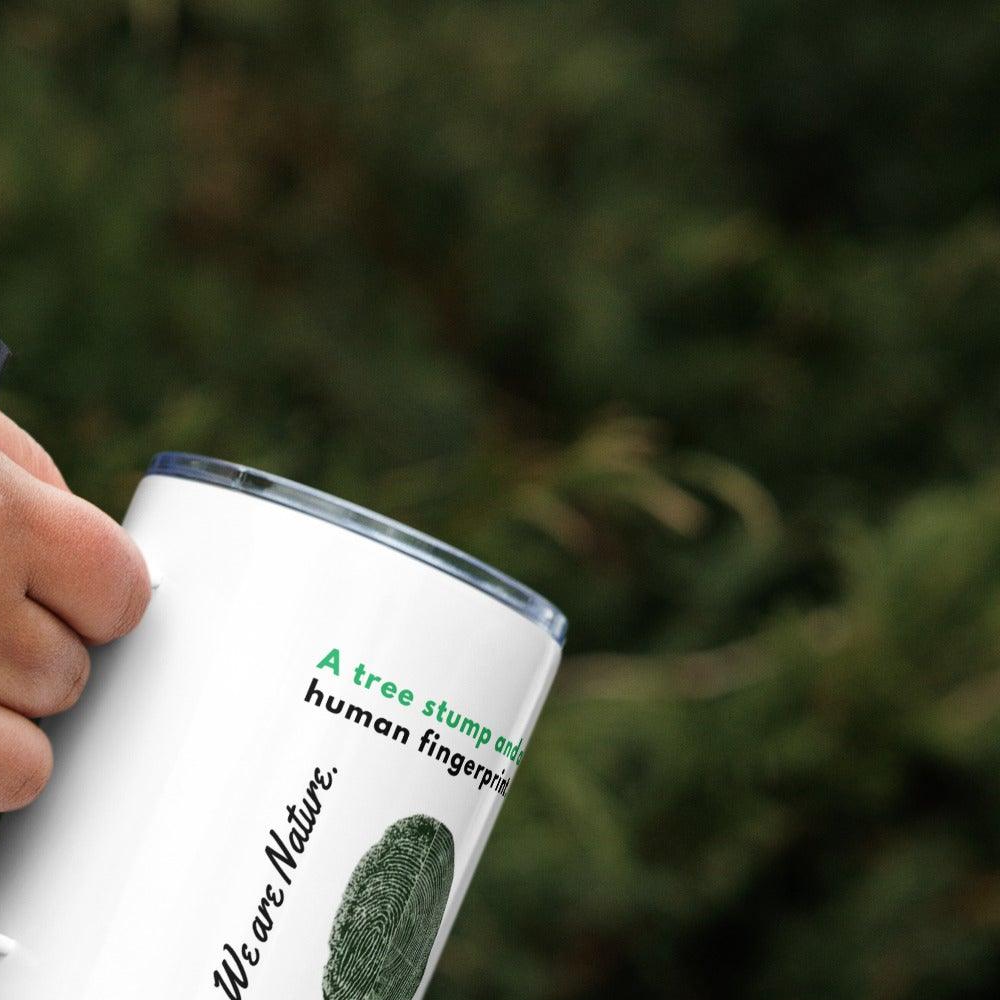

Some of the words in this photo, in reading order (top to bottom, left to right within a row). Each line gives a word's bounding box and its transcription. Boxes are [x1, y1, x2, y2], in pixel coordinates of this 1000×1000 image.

[304, 678, 411, 745] human
[316, 648, 340, 676] A
[354, 663, 414, 706] tree
[422, 698, 492, 747] stump
[265, 765, 338, 886] Nature.
[252, 884, 285, 943] are
